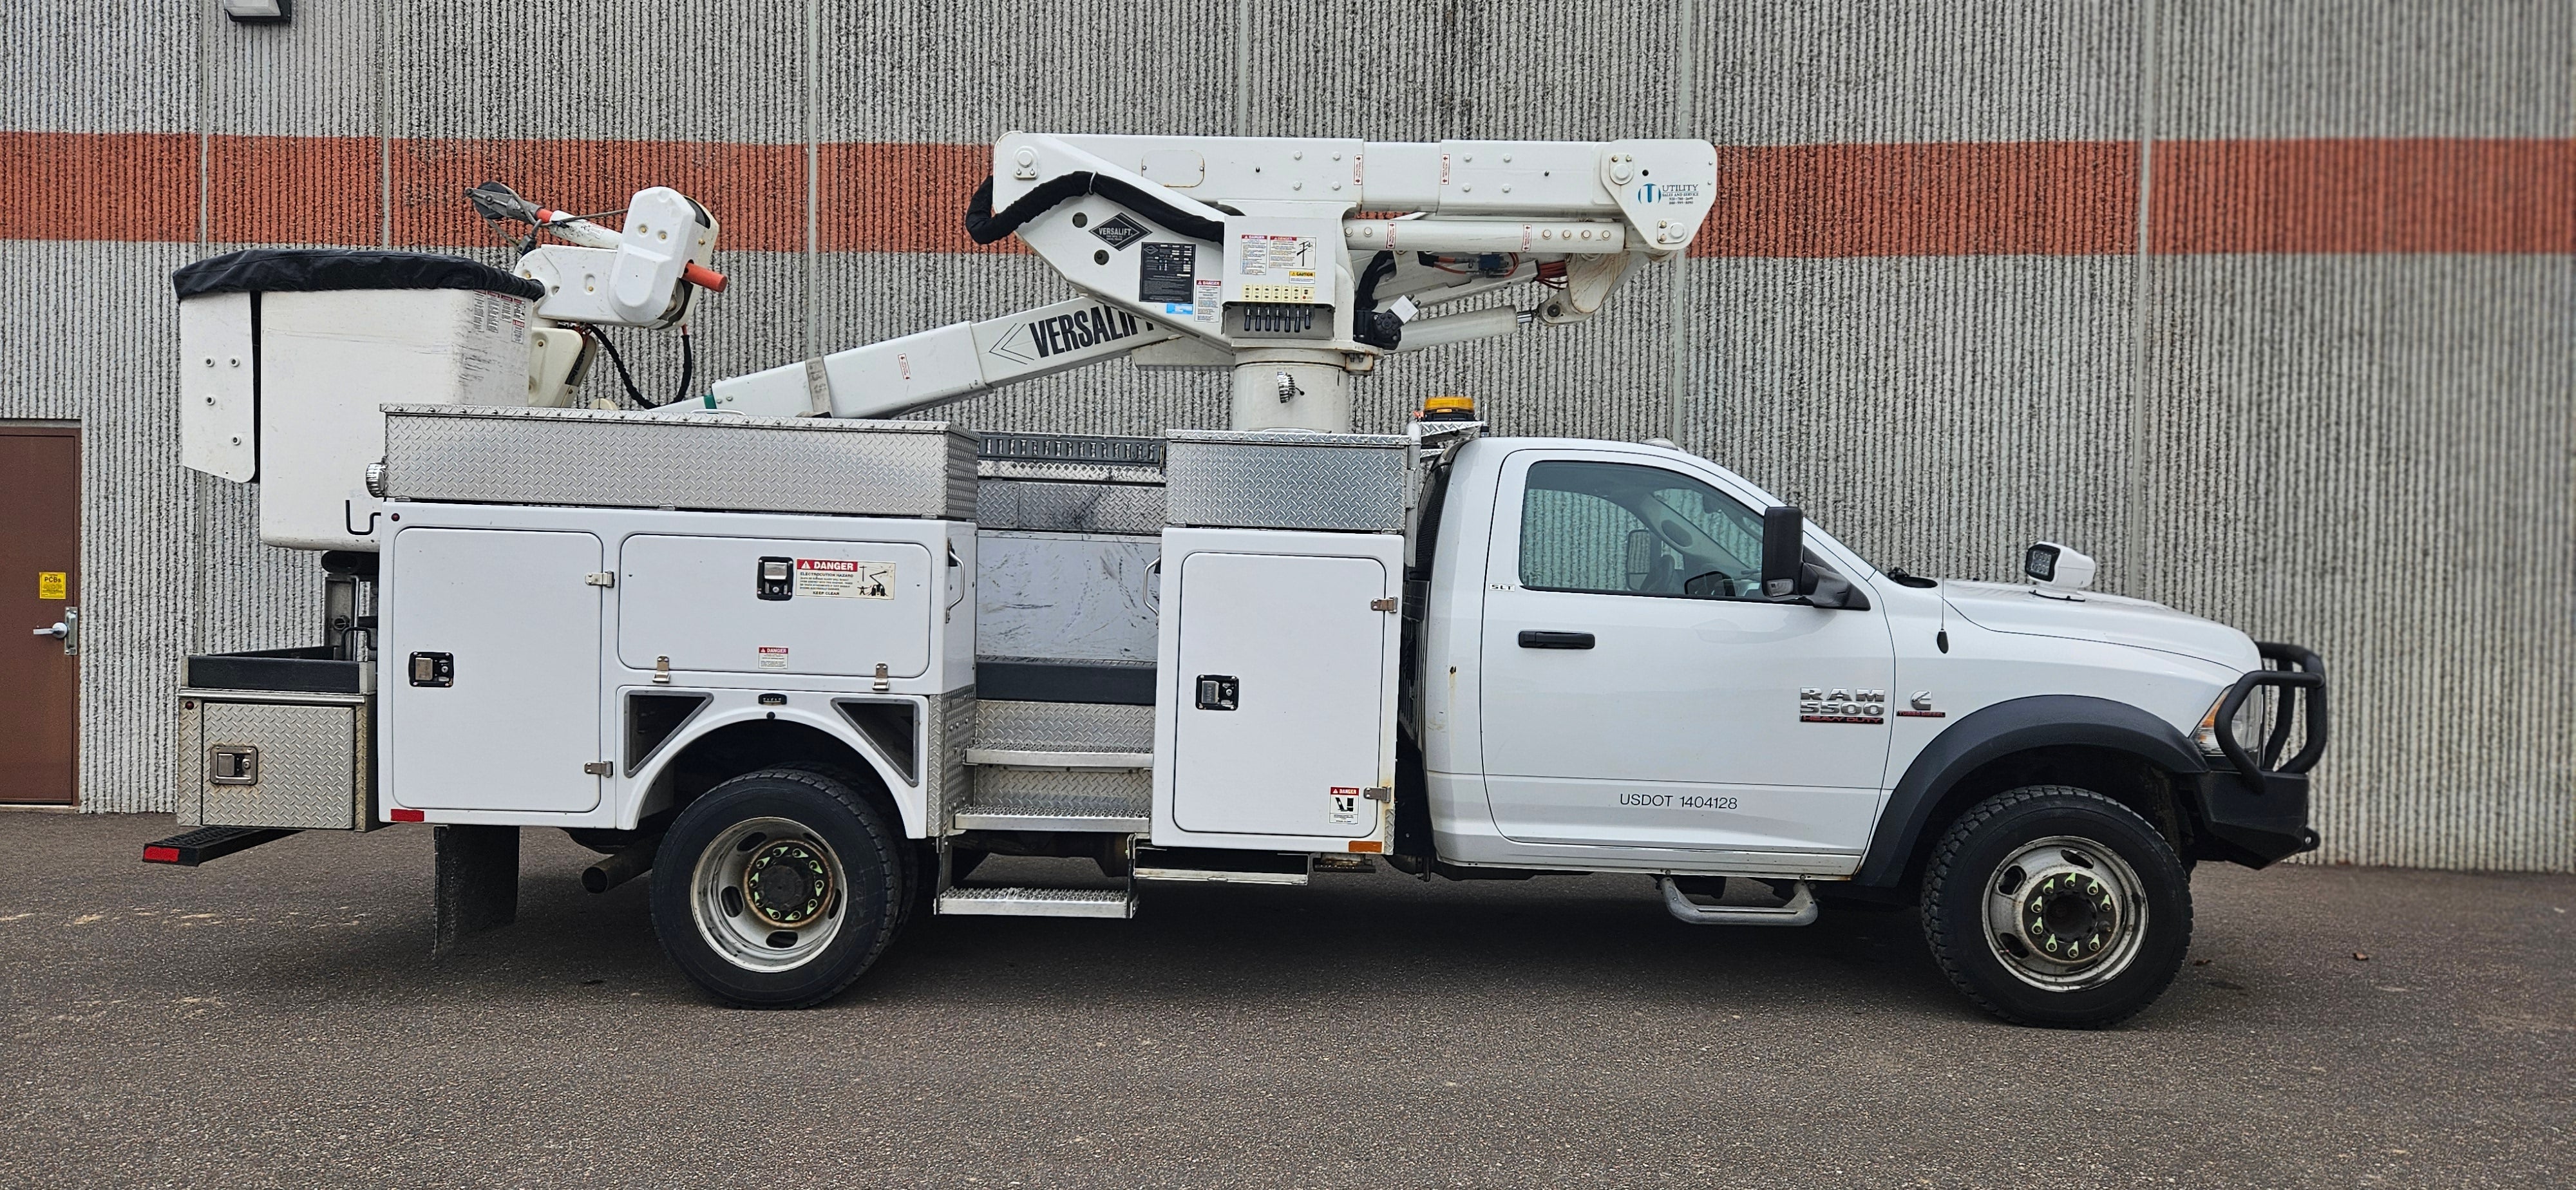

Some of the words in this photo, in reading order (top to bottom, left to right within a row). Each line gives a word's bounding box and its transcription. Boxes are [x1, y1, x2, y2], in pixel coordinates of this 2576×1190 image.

[1099, 227, 1132, 236] VERSALIFT
[1028, 305, 1154, 358] VERSALI
[814, 562, 853, 571] DANGER
[1800, 687, 1885, 701] RAM
[1800, 701, 1885, 715] 5500
[1620, 793, 1673, 807] USDOT
[1680, 796, 1738, 809] 1404128
